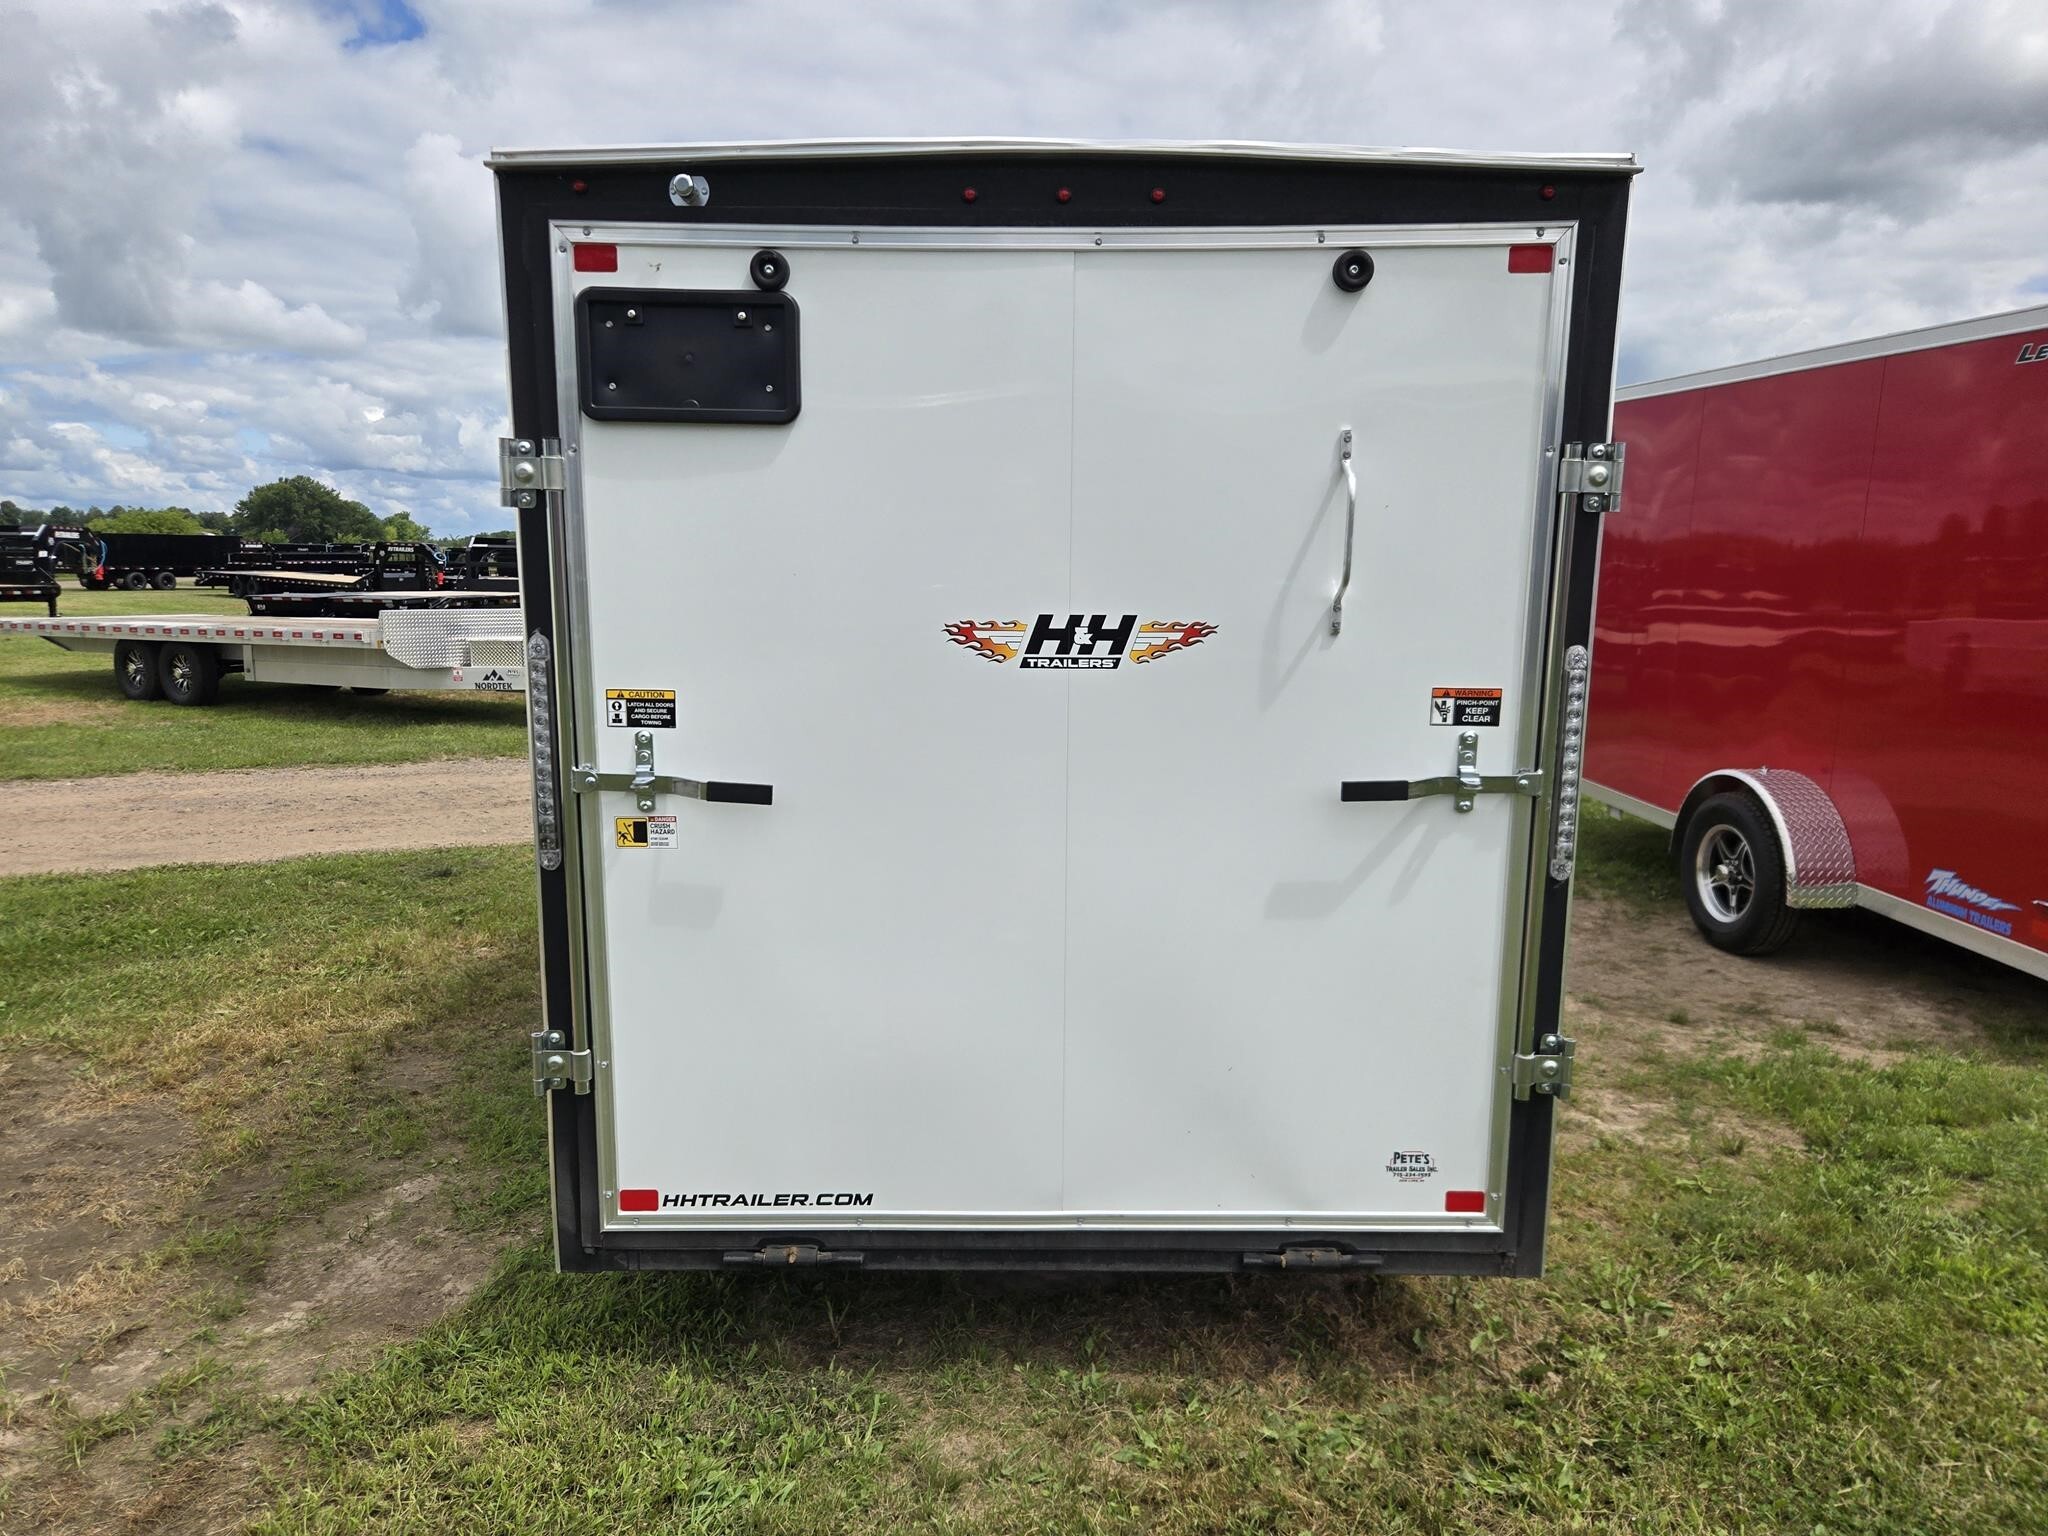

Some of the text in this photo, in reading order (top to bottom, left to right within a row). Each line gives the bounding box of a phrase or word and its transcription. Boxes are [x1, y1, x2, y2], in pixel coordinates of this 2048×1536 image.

[1024, 614, 1138, 655] H&H
[1027, 658, 1115, 668] TRAILERS
[475, 682, 513, 690] NORDTEK
[1461, 715, 1491, 723] CLEAR
[1393, 1151, 1430, 1165] PETE'S
[662, 1193, 874, 1207] HHTRAILER.COM
